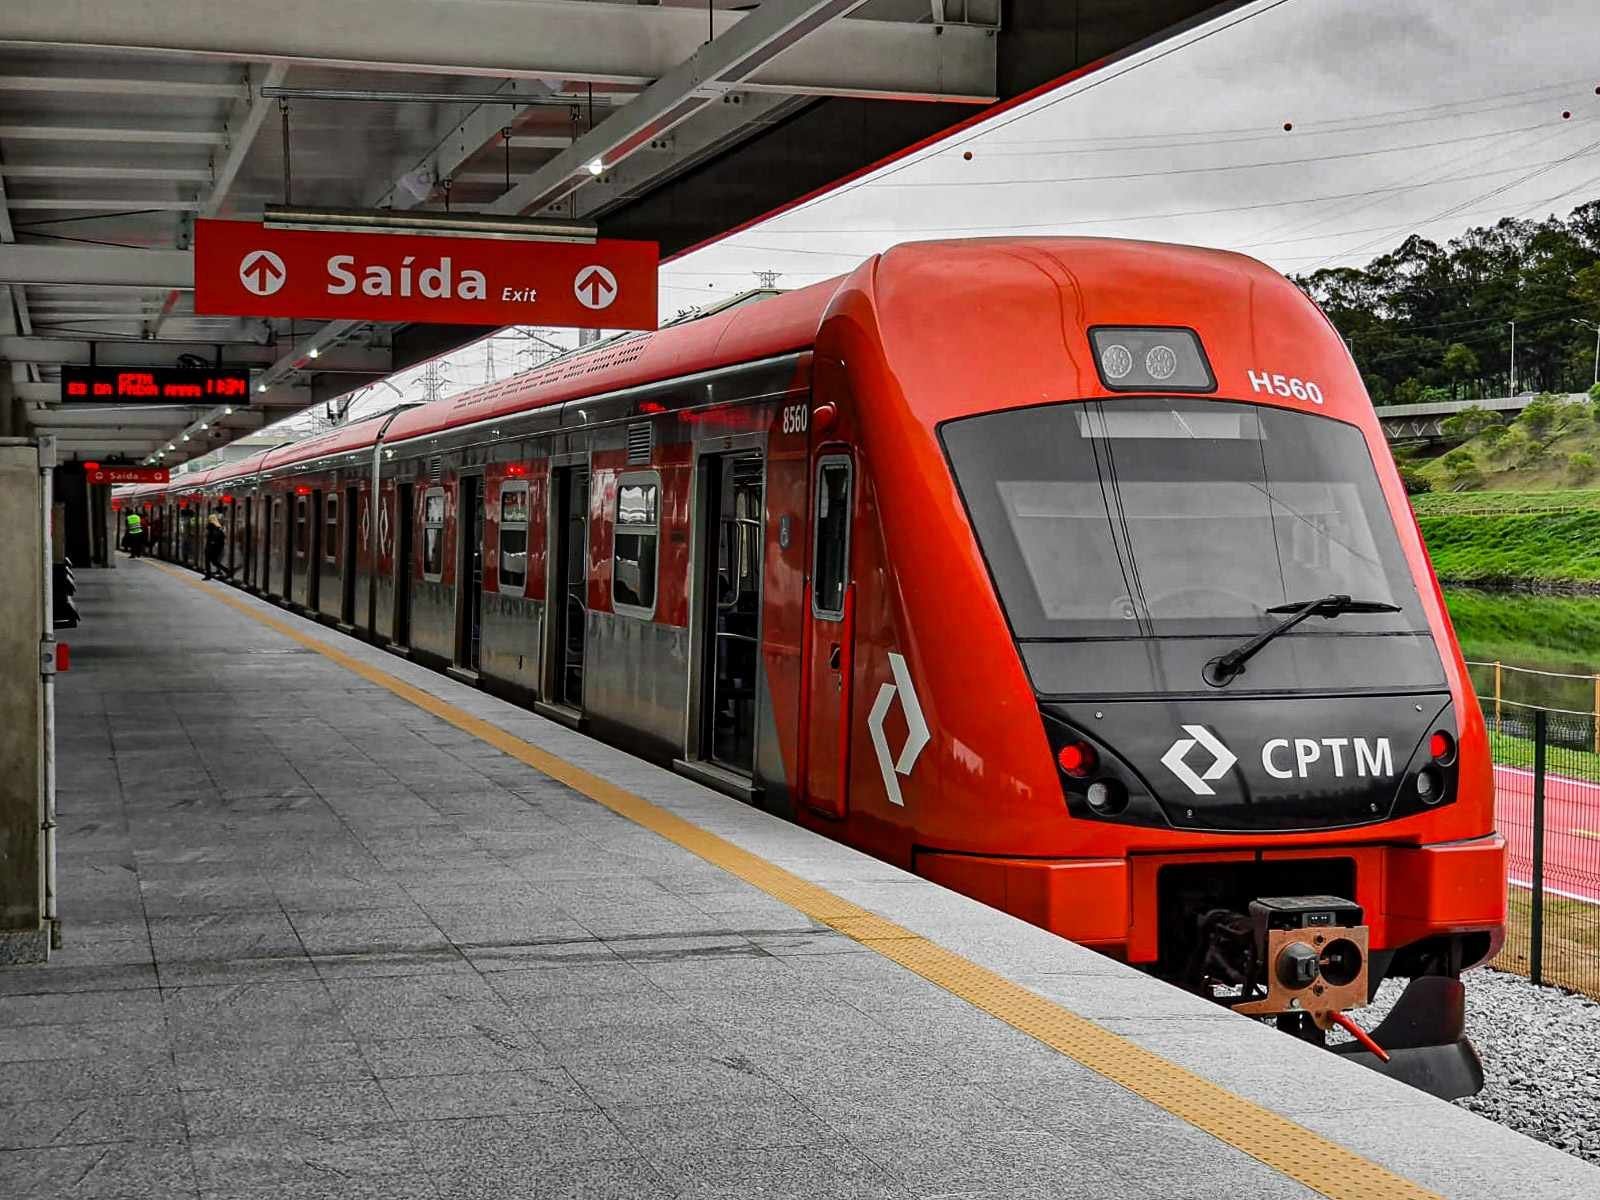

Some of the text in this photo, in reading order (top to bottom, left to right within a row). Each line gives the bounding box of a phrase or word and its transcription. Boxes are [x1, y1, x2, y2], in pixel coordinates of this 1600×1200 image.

[327, 254, 537, 302] Saída Exit
[1247, 370, 1324, 405] H560
[783, 404, 807, 434] 8560
[1261, 737, 1394, 779] CPTM
